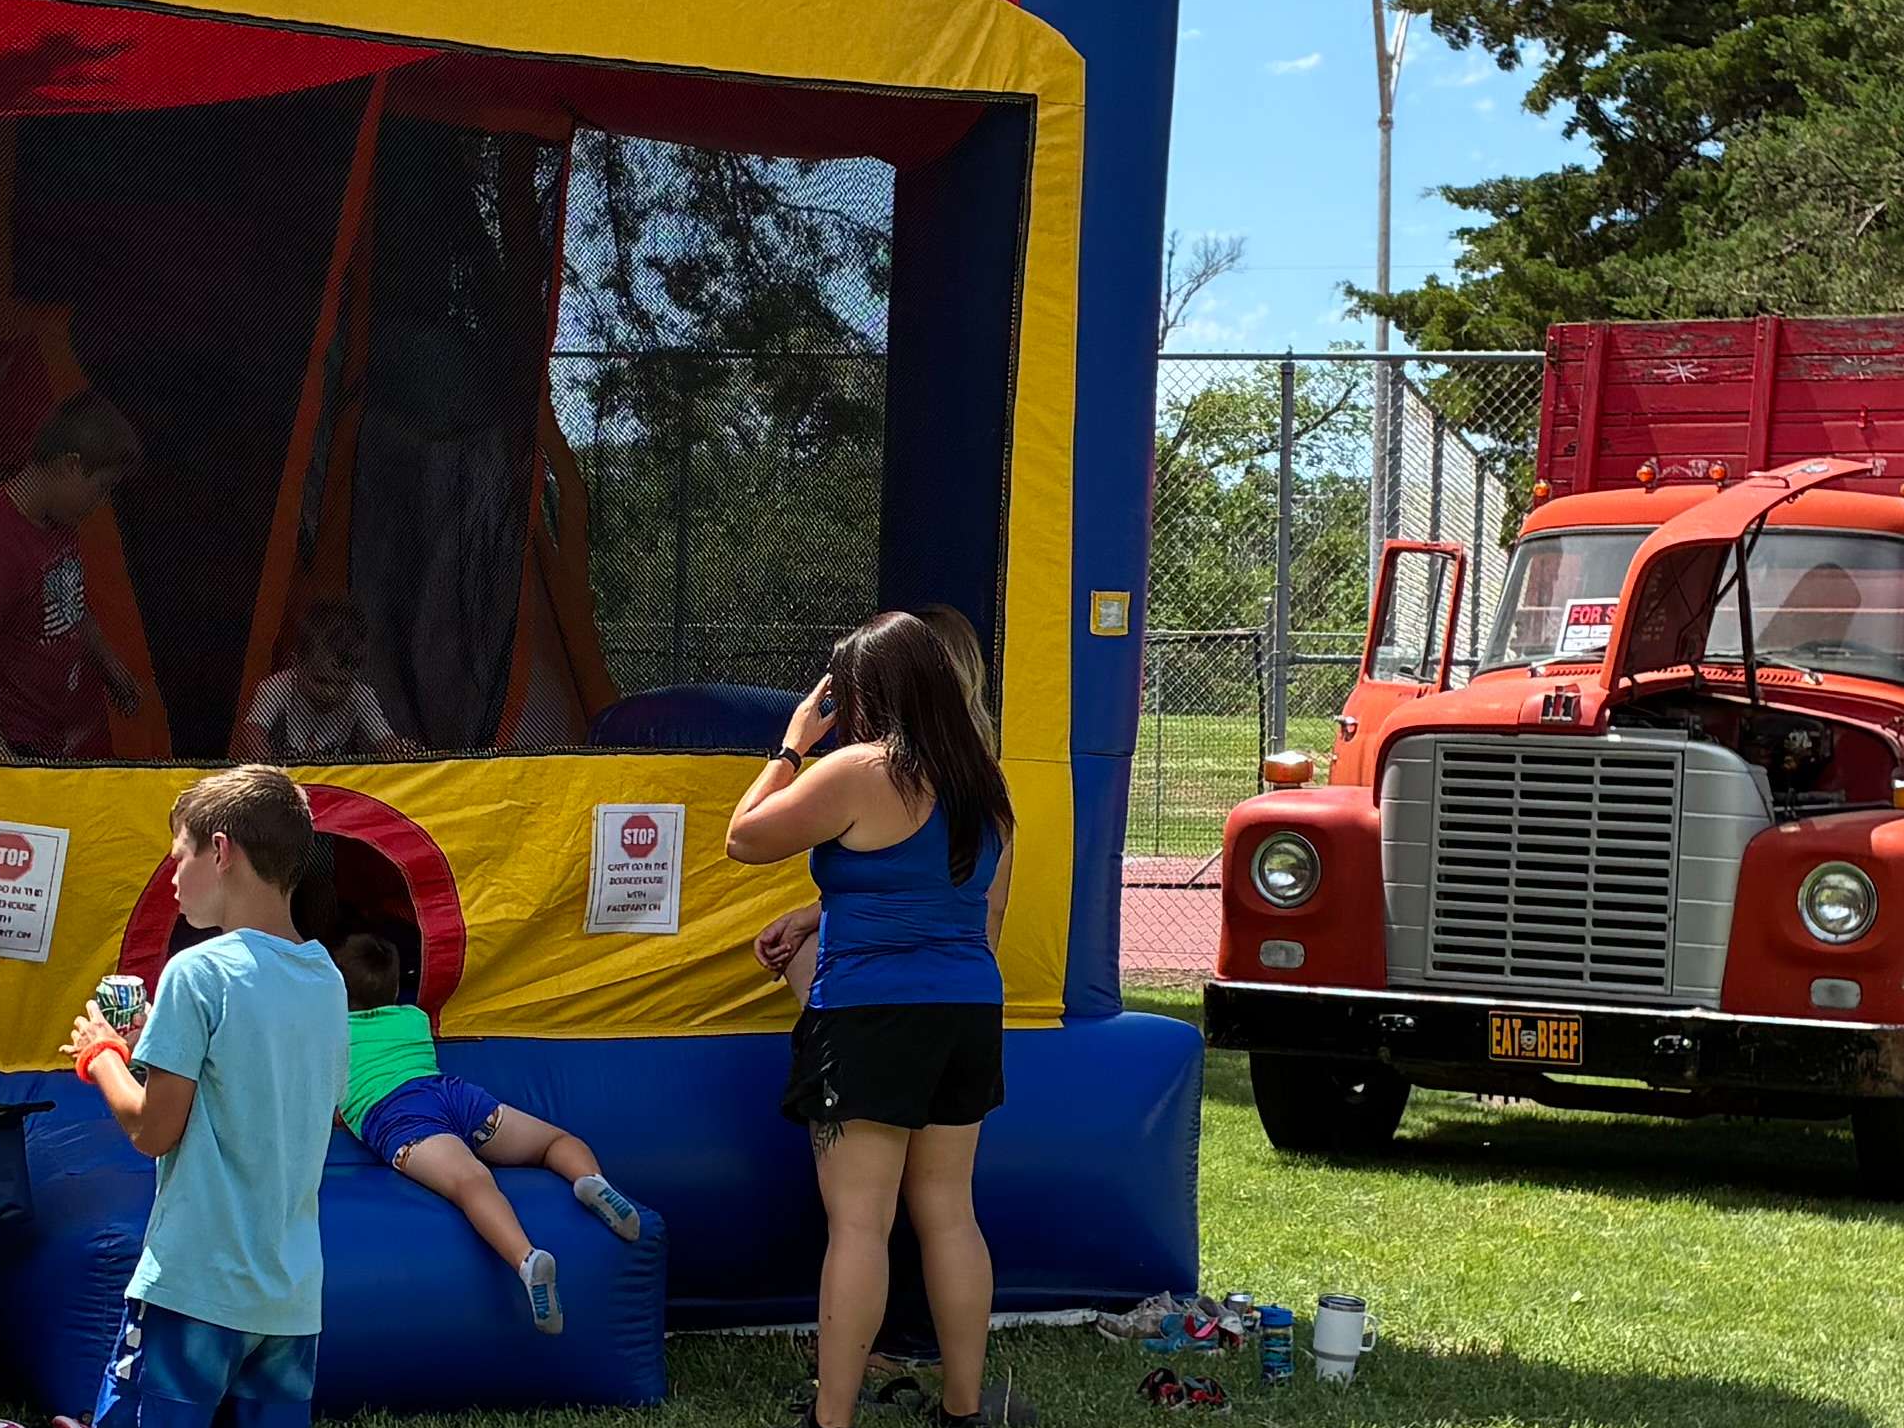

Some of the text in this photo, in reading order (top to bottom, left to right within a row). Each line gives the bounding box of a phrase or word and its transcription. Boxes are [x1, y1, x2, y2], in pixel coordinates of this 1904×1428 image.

[1569, 606, 1602, 624] FOR
[623, 828, 656, 845] STOP
[1492, 1017, 1579, 1060] EAT BEEF
